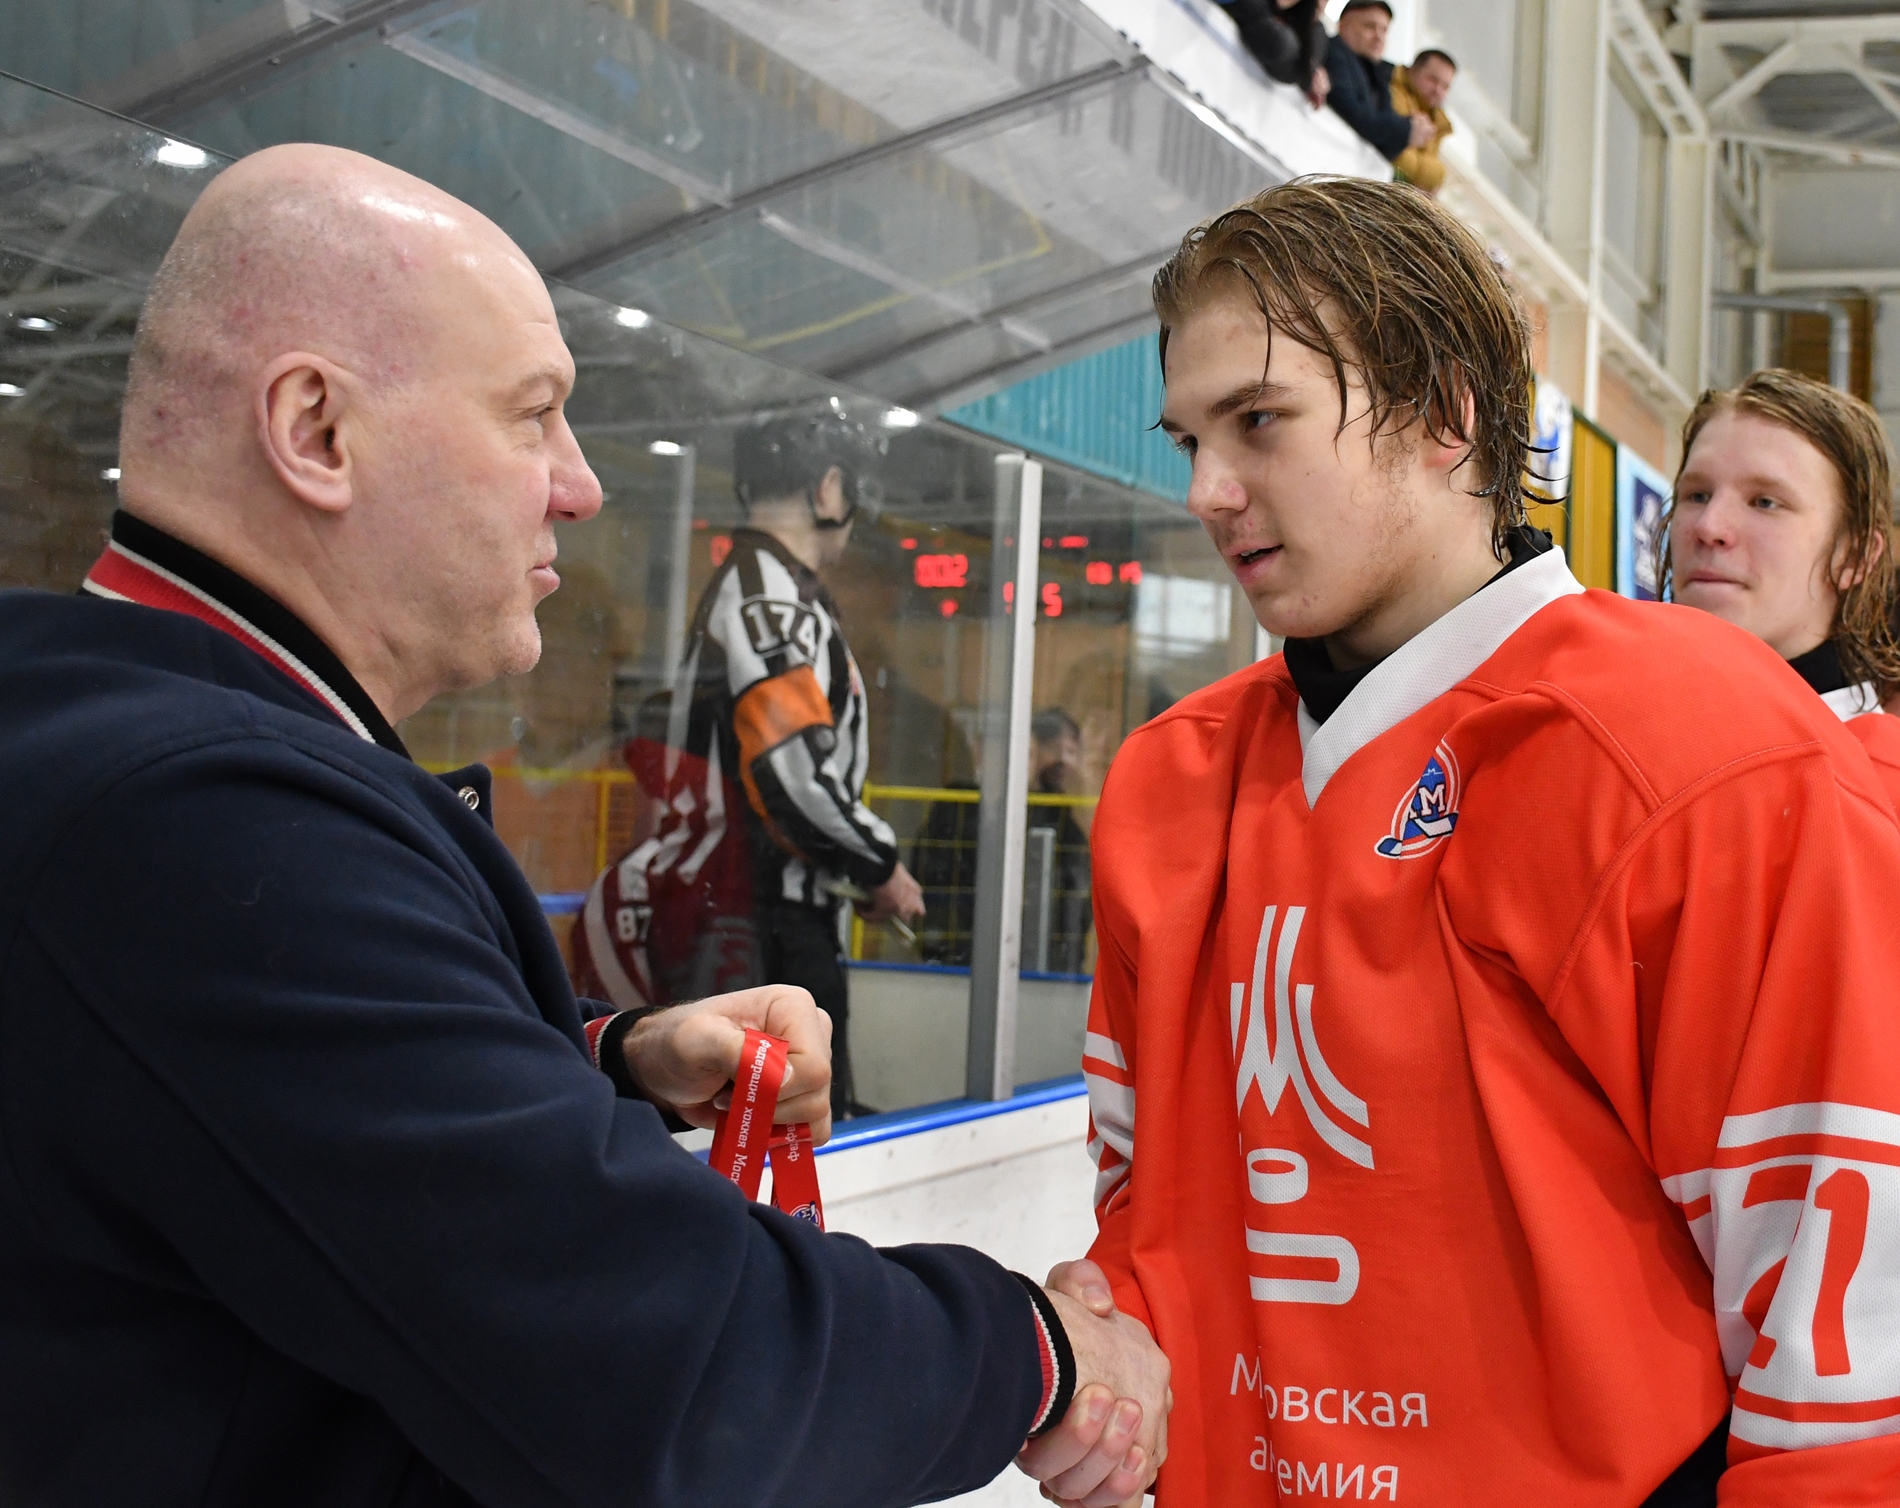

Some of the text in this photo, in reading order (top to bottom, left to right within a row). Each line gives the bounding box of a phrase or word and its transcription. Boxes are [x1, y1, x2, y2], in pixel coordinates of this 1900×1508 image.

[745, 602, 816, 659] 174
[615, 905, 654, 944] 87
[747, 1039, 772, 1103] Федерация
[737, 1107, 754, 1148] хоккея
